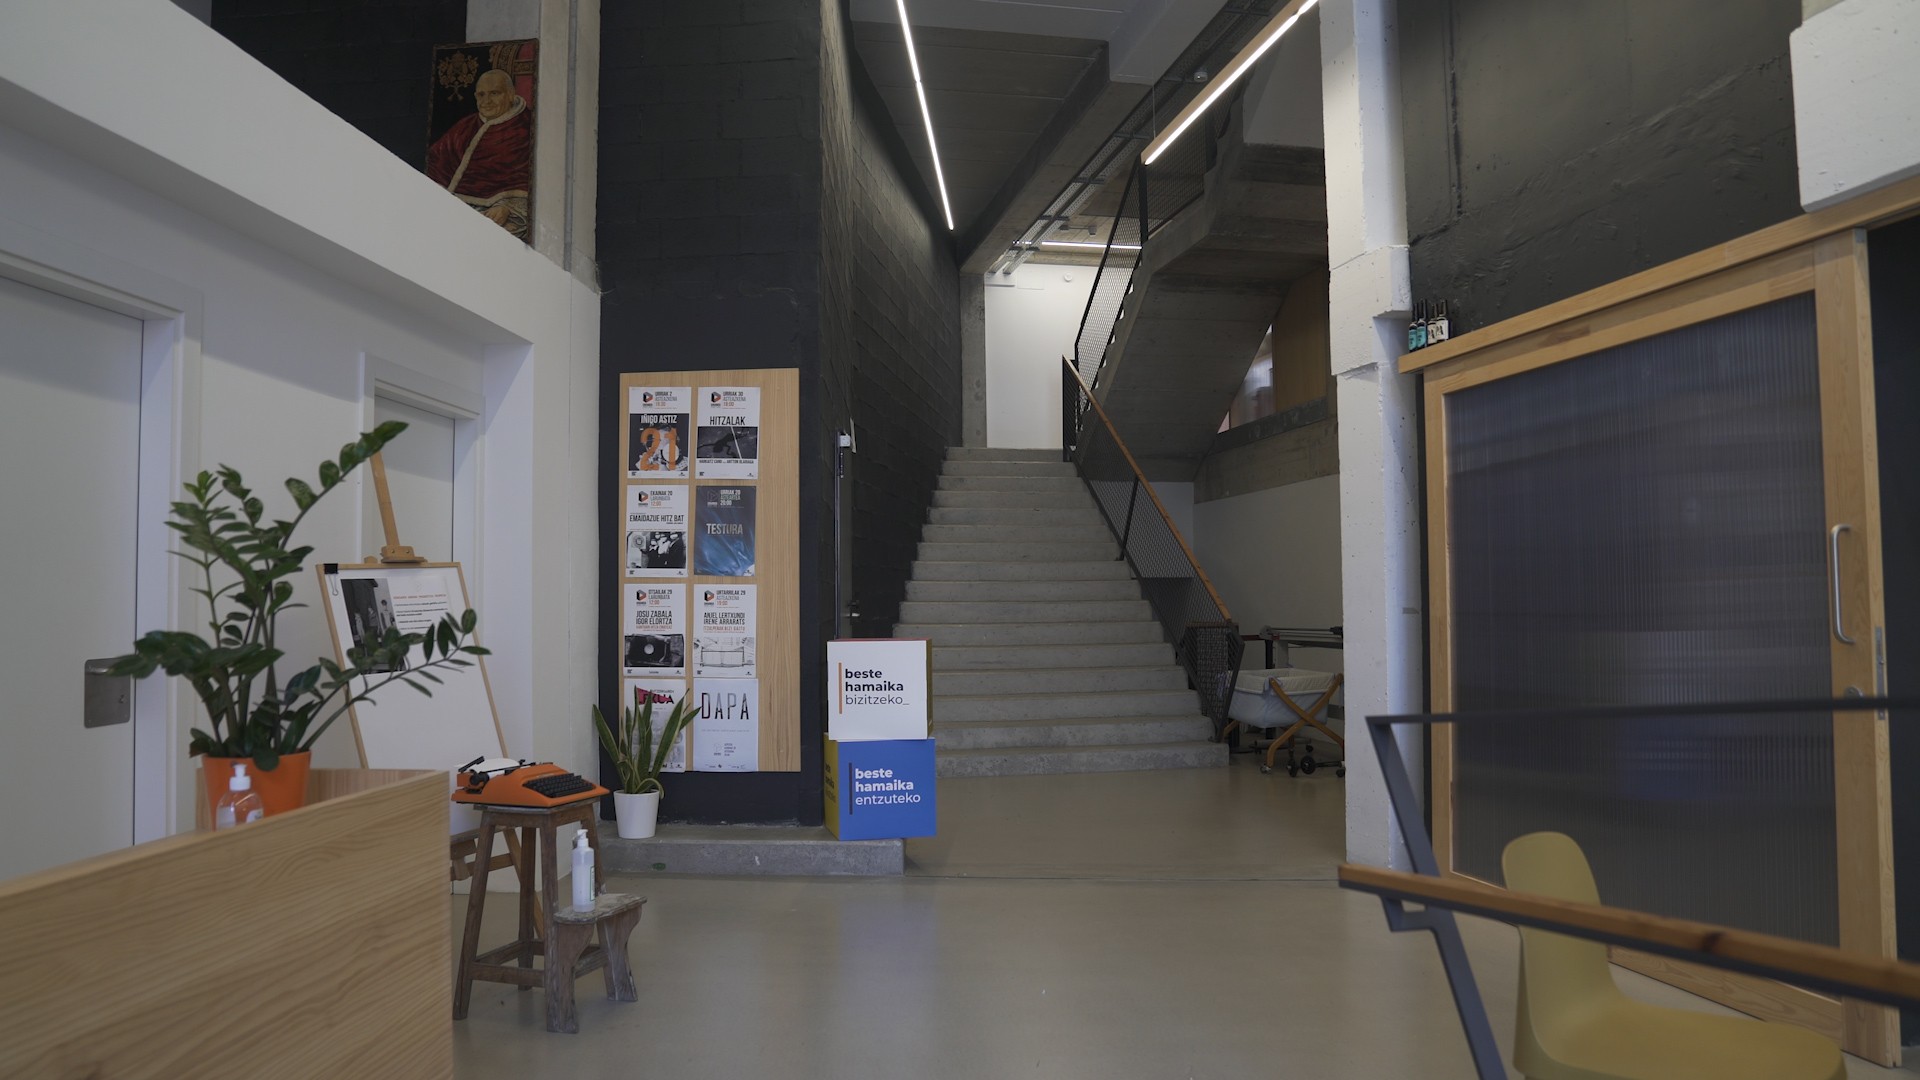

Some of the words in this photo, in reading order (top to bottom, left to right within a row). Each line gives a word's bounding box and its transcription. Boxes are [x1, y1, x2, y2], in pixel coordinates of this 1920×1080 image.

[640, 414, 658, 424] IÑIGO
[659, 414, 678, 424] ASTIZ
[710, 416, 746, 426] HITZALAK
[640, 428, 678, 470] 21
[706, 523, 744, 535] TESTURA
[845, 668, 882, 679] beste
[845, 681, 904, 692] hamaika
[702, 692, 749, 720] DAPA
[855, 768, 893, 779] beste
[855, 780, 914, 792] hamaika
[855, 792, 921, 806] entzuteko
